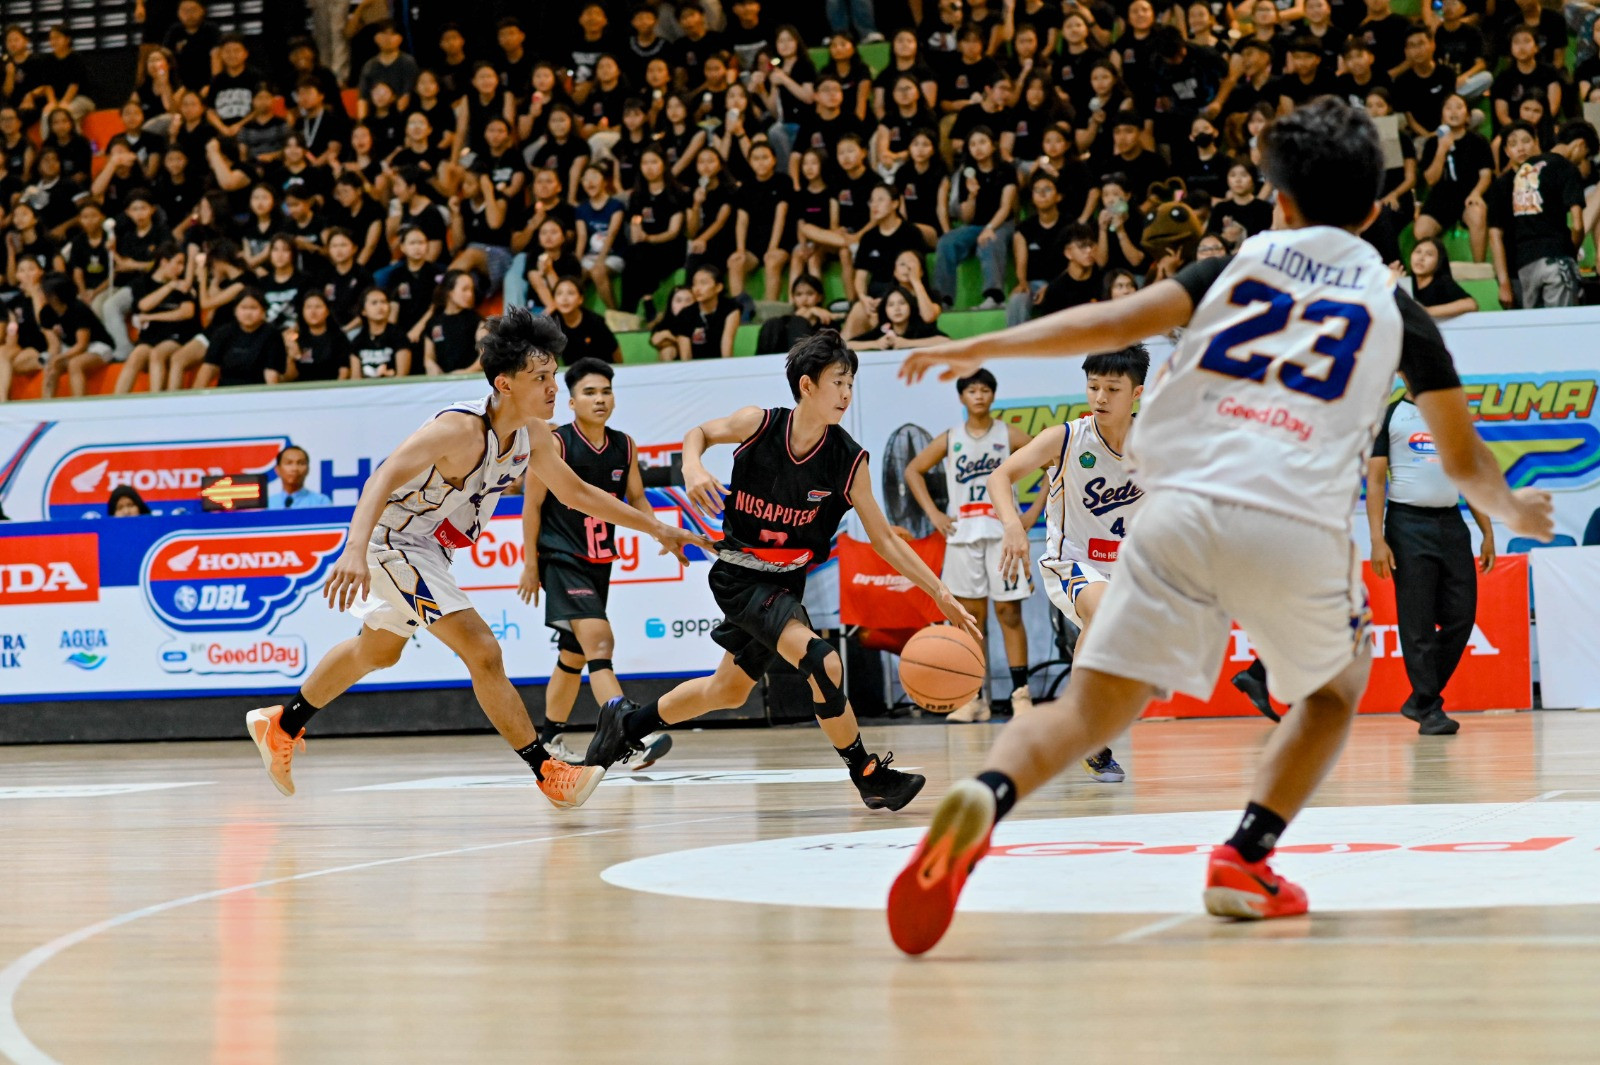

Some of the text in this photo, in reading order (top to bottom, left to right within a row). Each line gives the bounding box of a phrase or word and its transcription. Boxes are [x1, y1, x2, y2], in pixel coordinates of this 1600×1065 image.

[1198, 276, 1373, 403] 23
[969, 485, 986, 502] 17
[735, 490, 820, 527] NUSAPUTER
[584, 517, 613, 559] 12
[1110, 517, 1126, 538] 4
[198, 551, 303, 570] HONDA
[1092, 550, 1107, 559] One
[198, 584, 250, 611] DBL
[672, 618, 722, 638] gopa
[60, 630, 108, 651] AQUA
